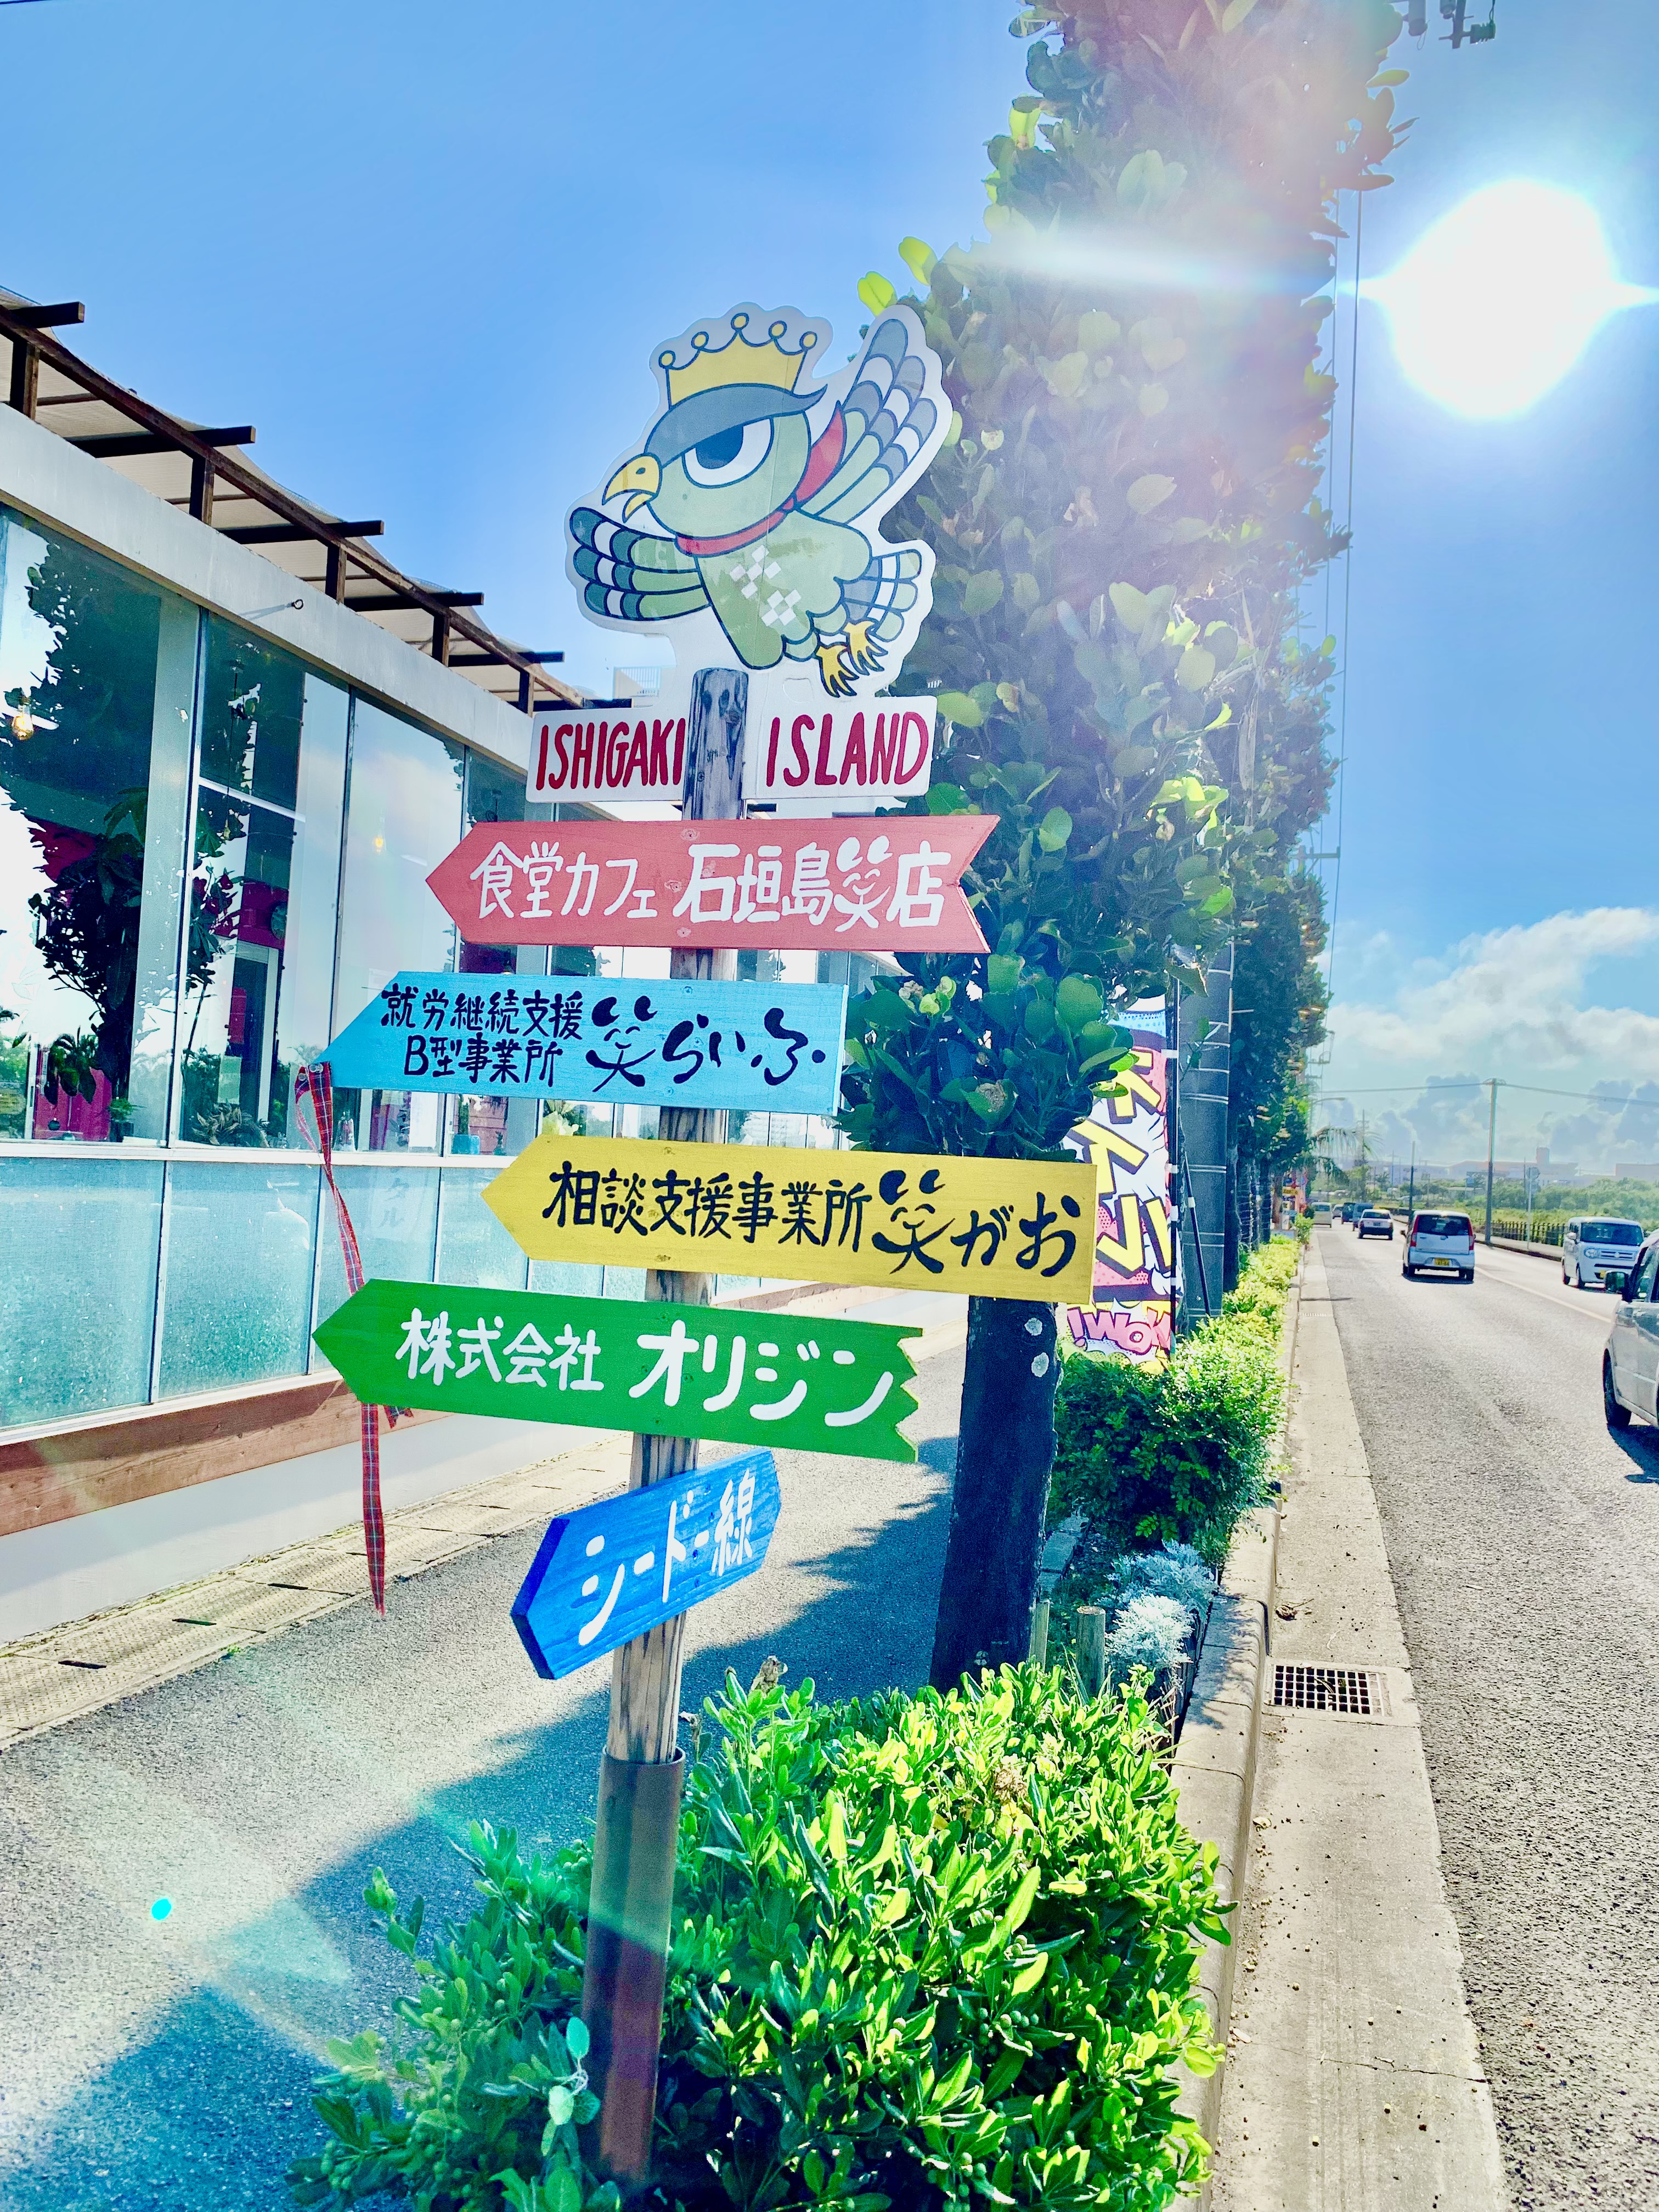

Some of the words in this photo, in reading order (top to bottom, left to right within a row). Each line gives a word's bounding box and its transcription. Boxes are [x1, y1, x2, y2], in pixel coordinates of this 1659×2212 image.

[535, 718, 686, 791] ISHIGAKI
[766, 712, 928, 787] ISLAND
[470, 840, 658, 919] 食堂カフェ
[673, 835, 952, 932] 石垣島笑店
[381, 983, 583, 1040] 就労継続支援
[404, 1032, 563, 1087] B型事業所
[542, 1161, 873, 1252] 相談支援事業所
[395, 1307, 604, 1391] 株式会社
[629, 1319, 894, 1427] オリジン
[578, 1468, 756, 1646] シードー線
